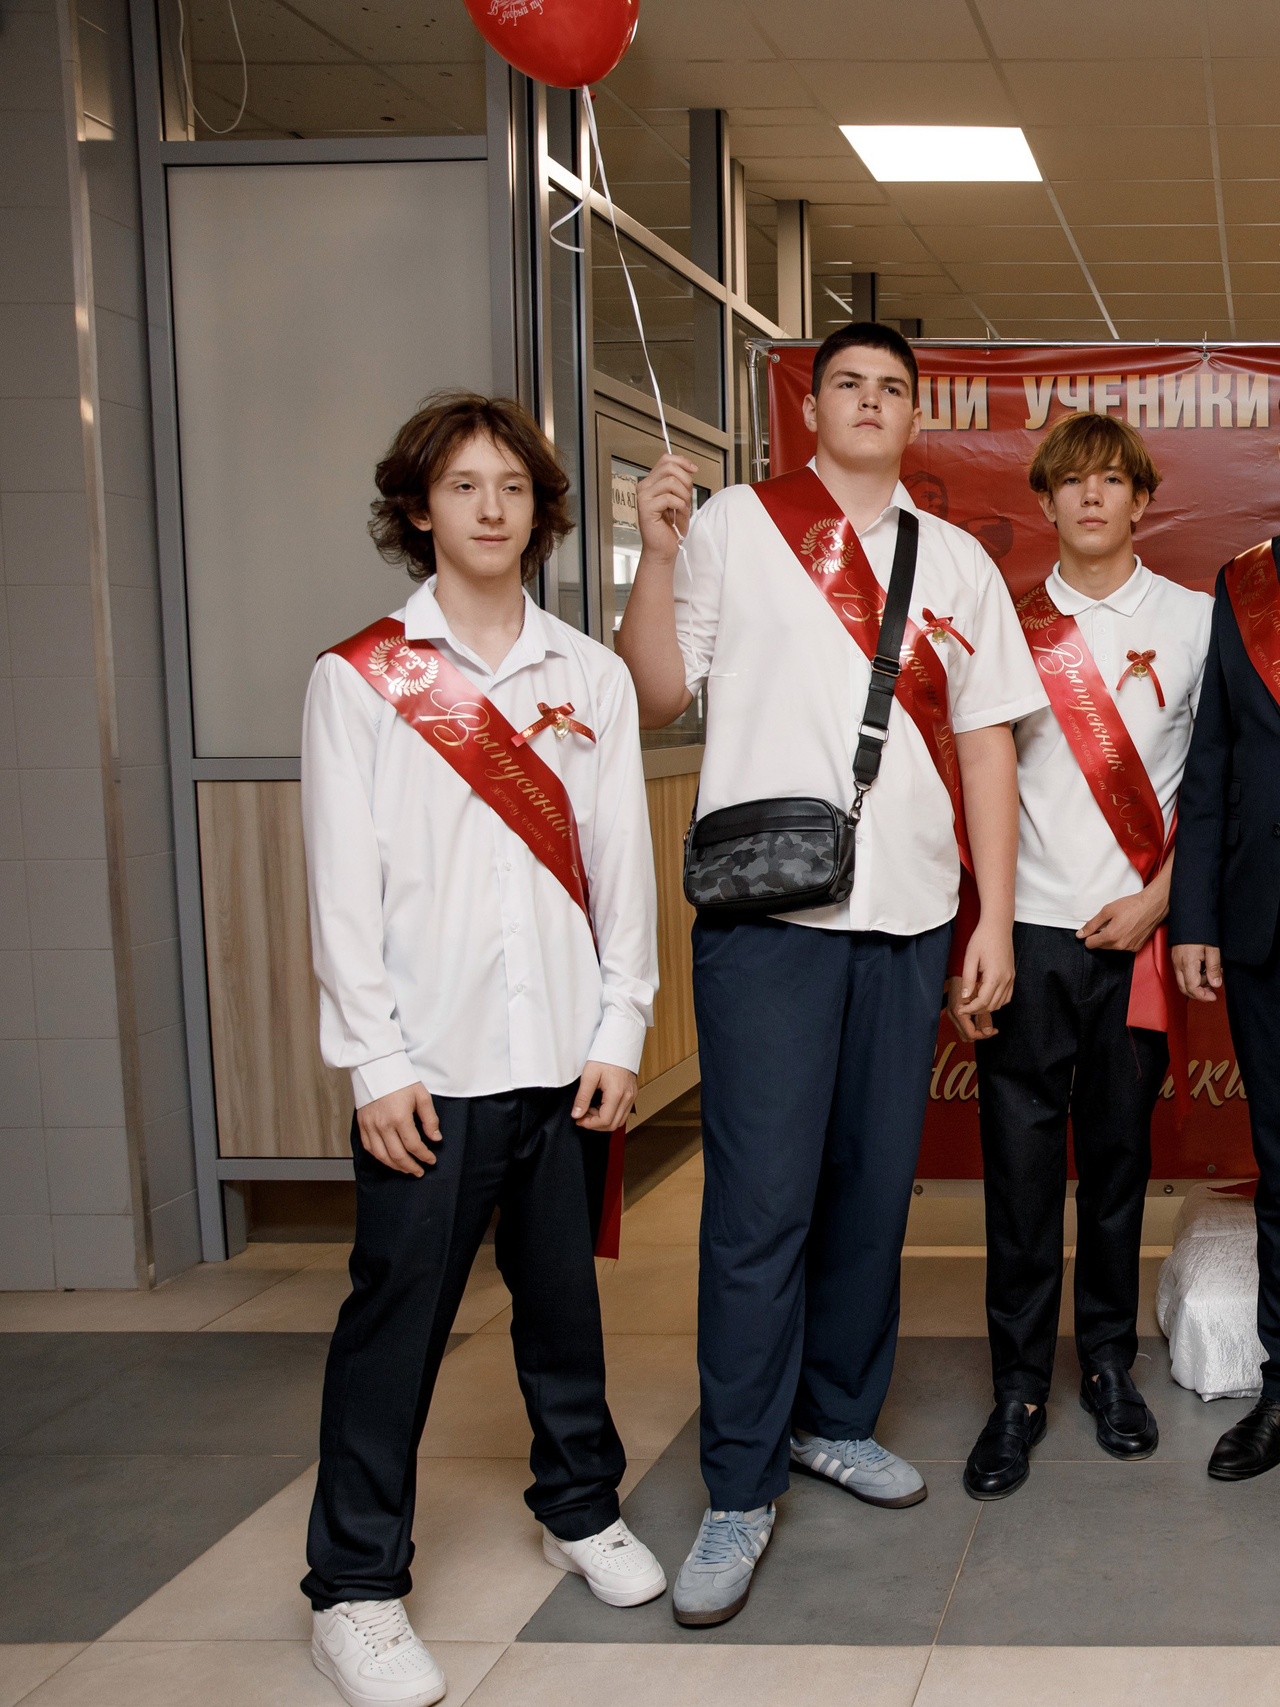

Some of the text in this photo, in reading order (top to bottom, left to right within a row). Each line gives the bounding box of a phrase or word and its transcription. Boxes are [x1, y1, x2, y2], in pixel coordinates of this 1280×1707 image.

[530, 0, 544, 15] пу
[918, 376, 988, 430] ШИ
[1022, 374, 1269, 430] УЧЕНИКИ
[389, 658, 410, 678] класс
[1033, 628, 1126, 773] Выпускник
[418, 689, 573, 839] Выпускник
